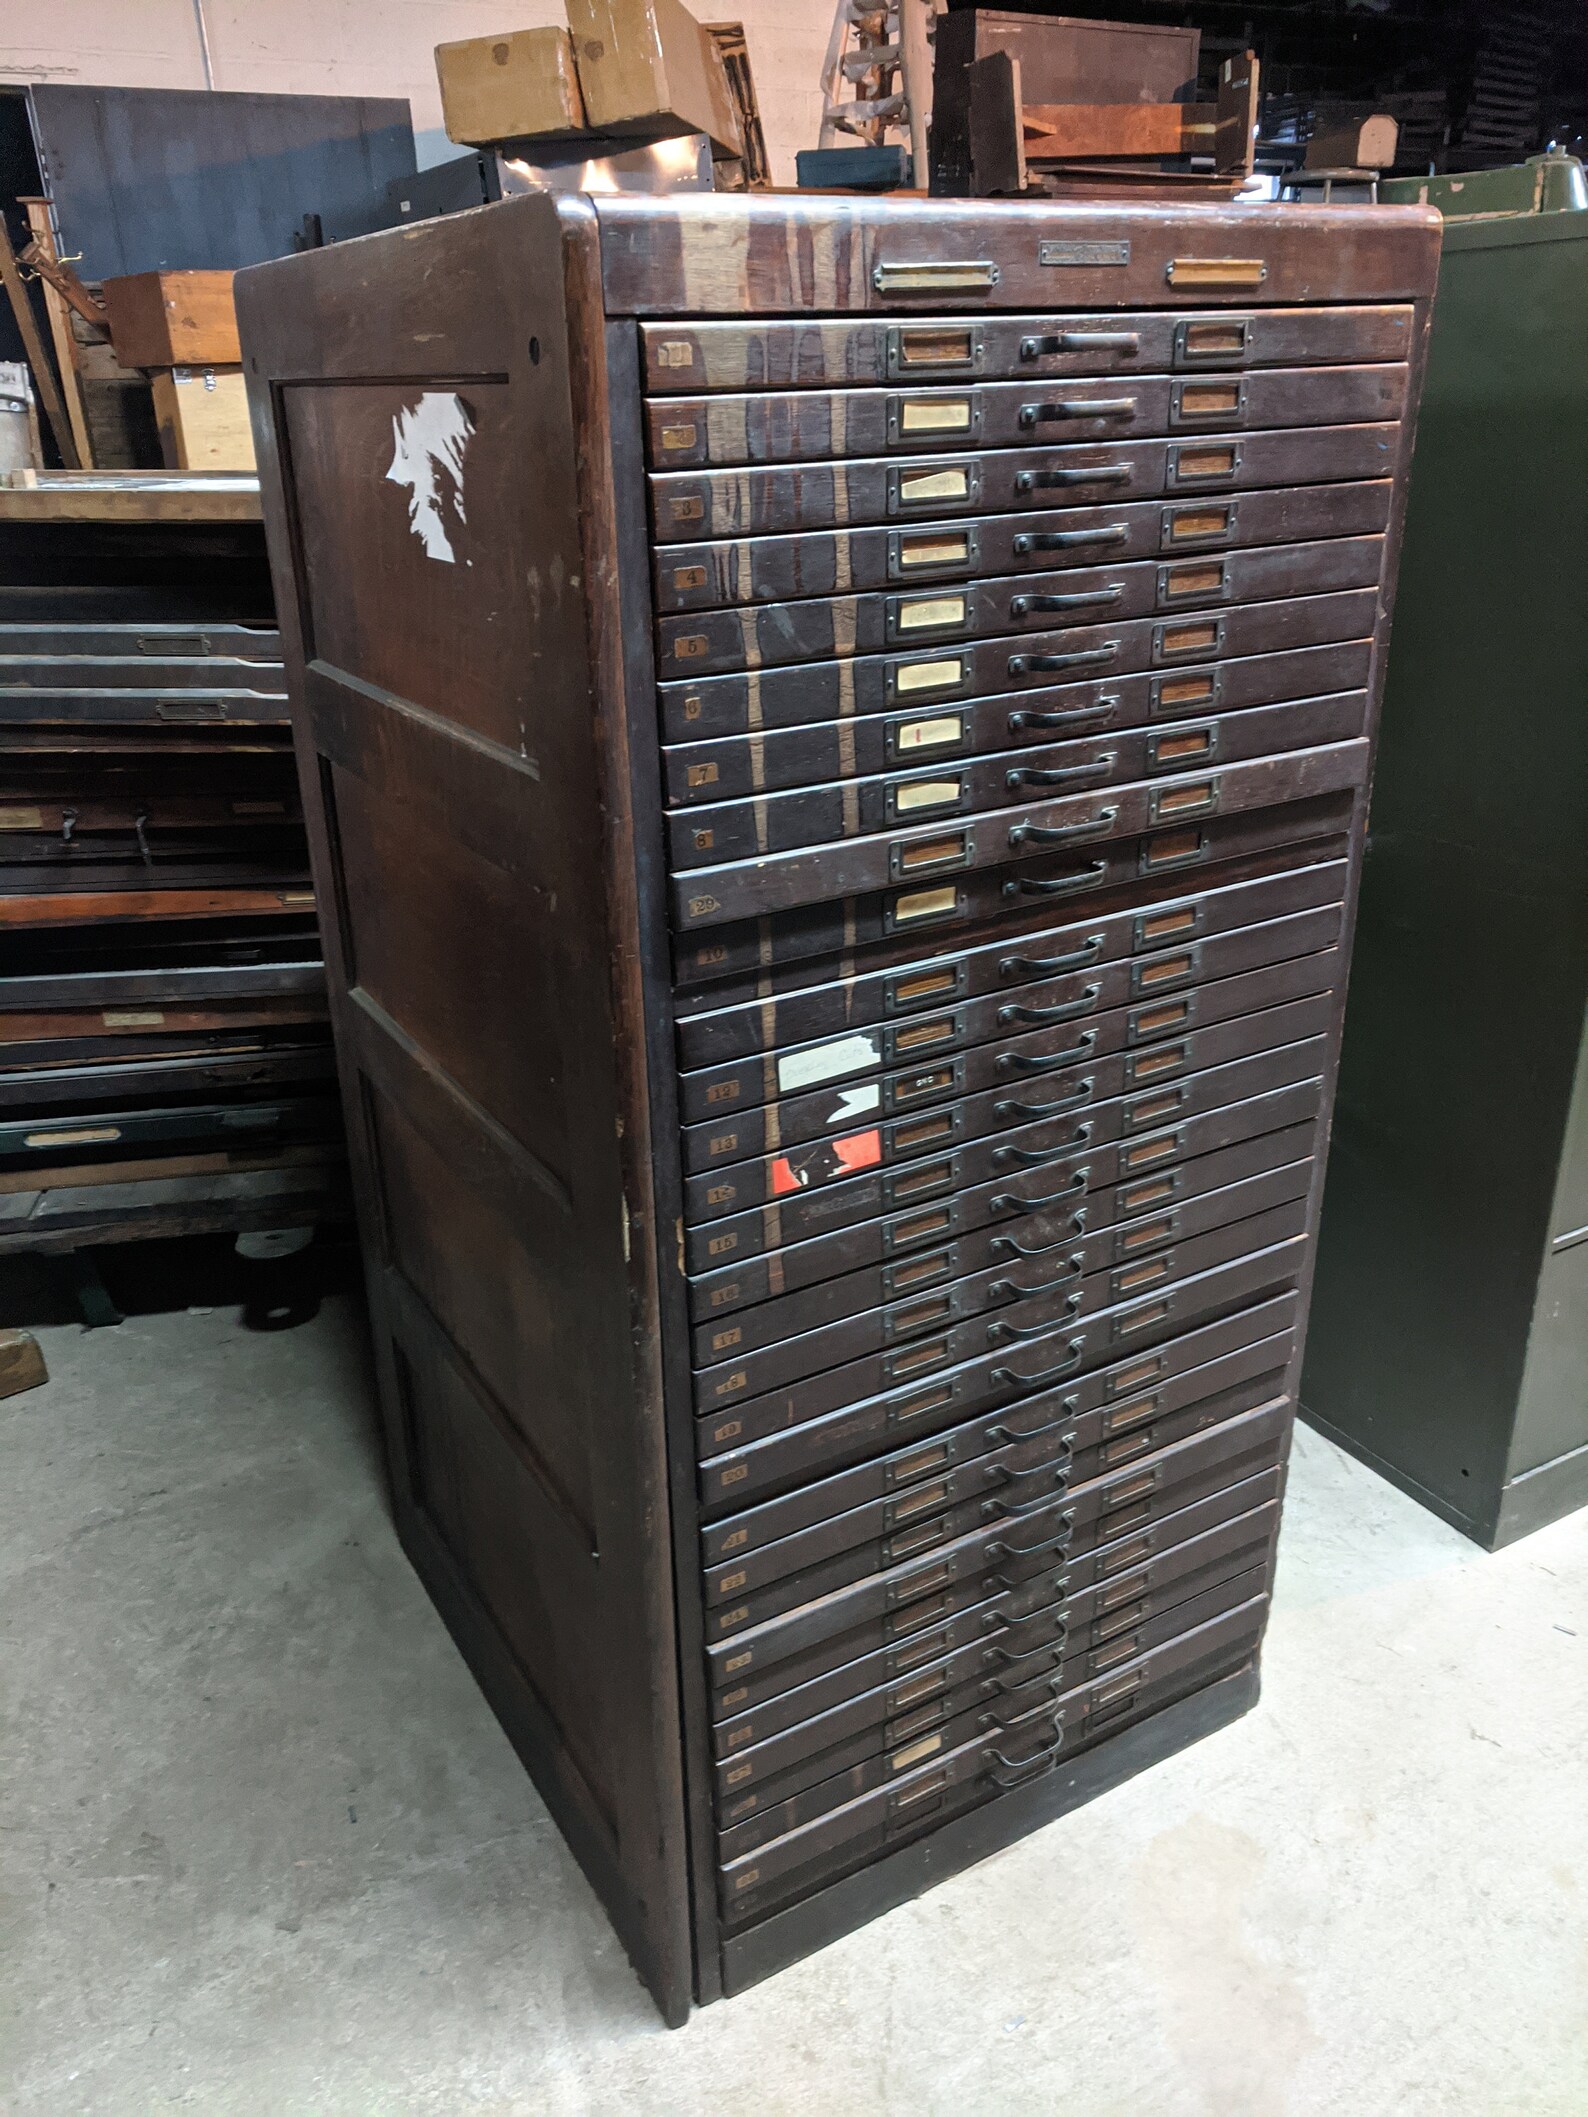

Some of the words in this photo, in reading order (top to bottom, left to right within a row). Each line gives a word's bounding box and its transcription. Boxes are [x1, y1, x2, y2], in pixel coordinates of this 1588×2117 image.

[682, 501, 692, 516] 3
[687, 571, 697, 585] 4
[688, 640, 698, 654] 5
[688, 700, 698, 714] 6
[699, 767, 708, 782] 7
[697, 833, 706, 847] 8
[696, 897, 714, 912] 29
[706, 947, 723, 961] 10
[715, 1086, 731, 1100] 12
[717, 1137, 733, 1151] 13
[716, 1237, 732, 1251] 15
[721, 1330, 737, 1345] 17
